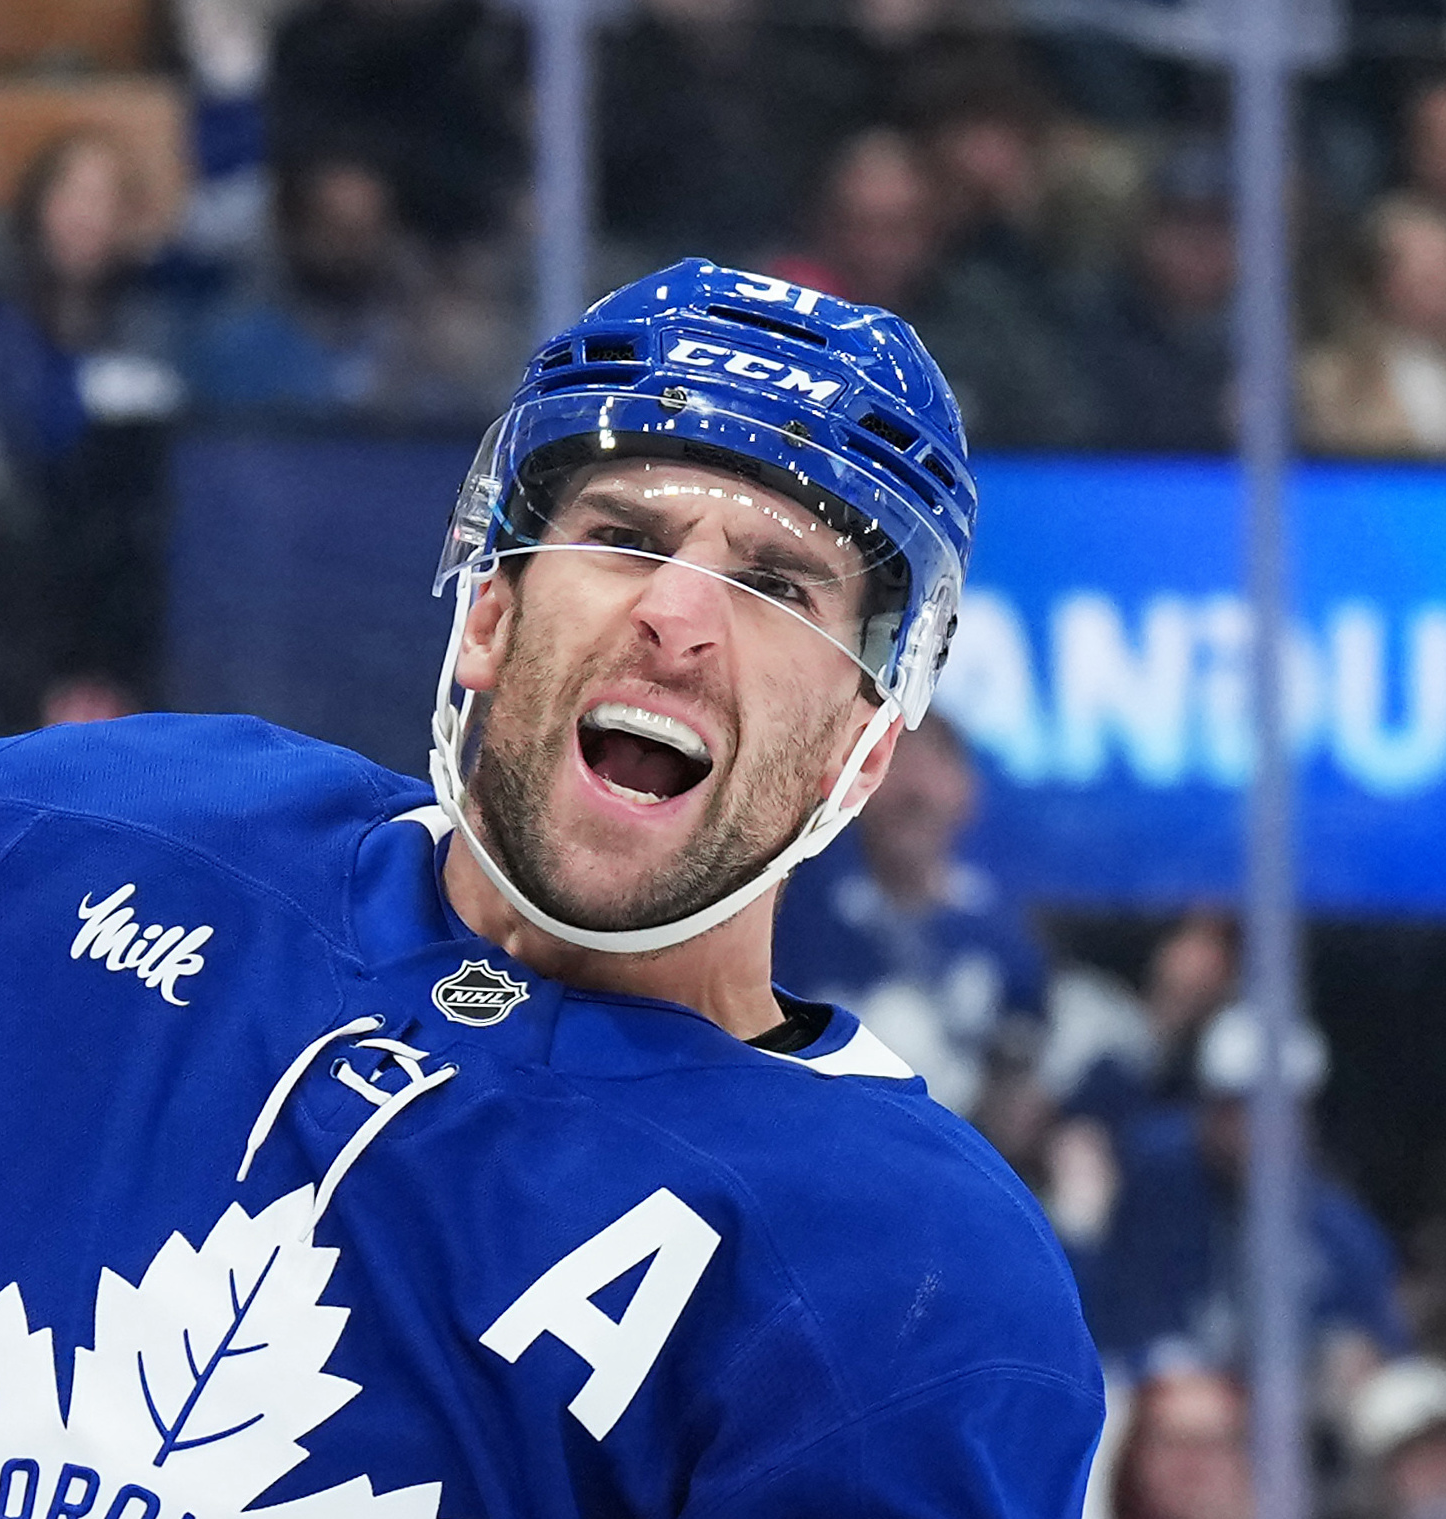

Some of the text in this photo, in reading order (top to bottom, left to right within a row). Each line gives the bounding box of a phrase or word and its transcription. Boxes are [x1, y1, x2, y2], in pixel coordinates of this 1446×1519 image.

[666, 337, 842, 402] CCM
[69, 882, 214, 1007] Milk
[447, 990, 507, 1004] NHL
[479, 1187, 722, 1442] A
